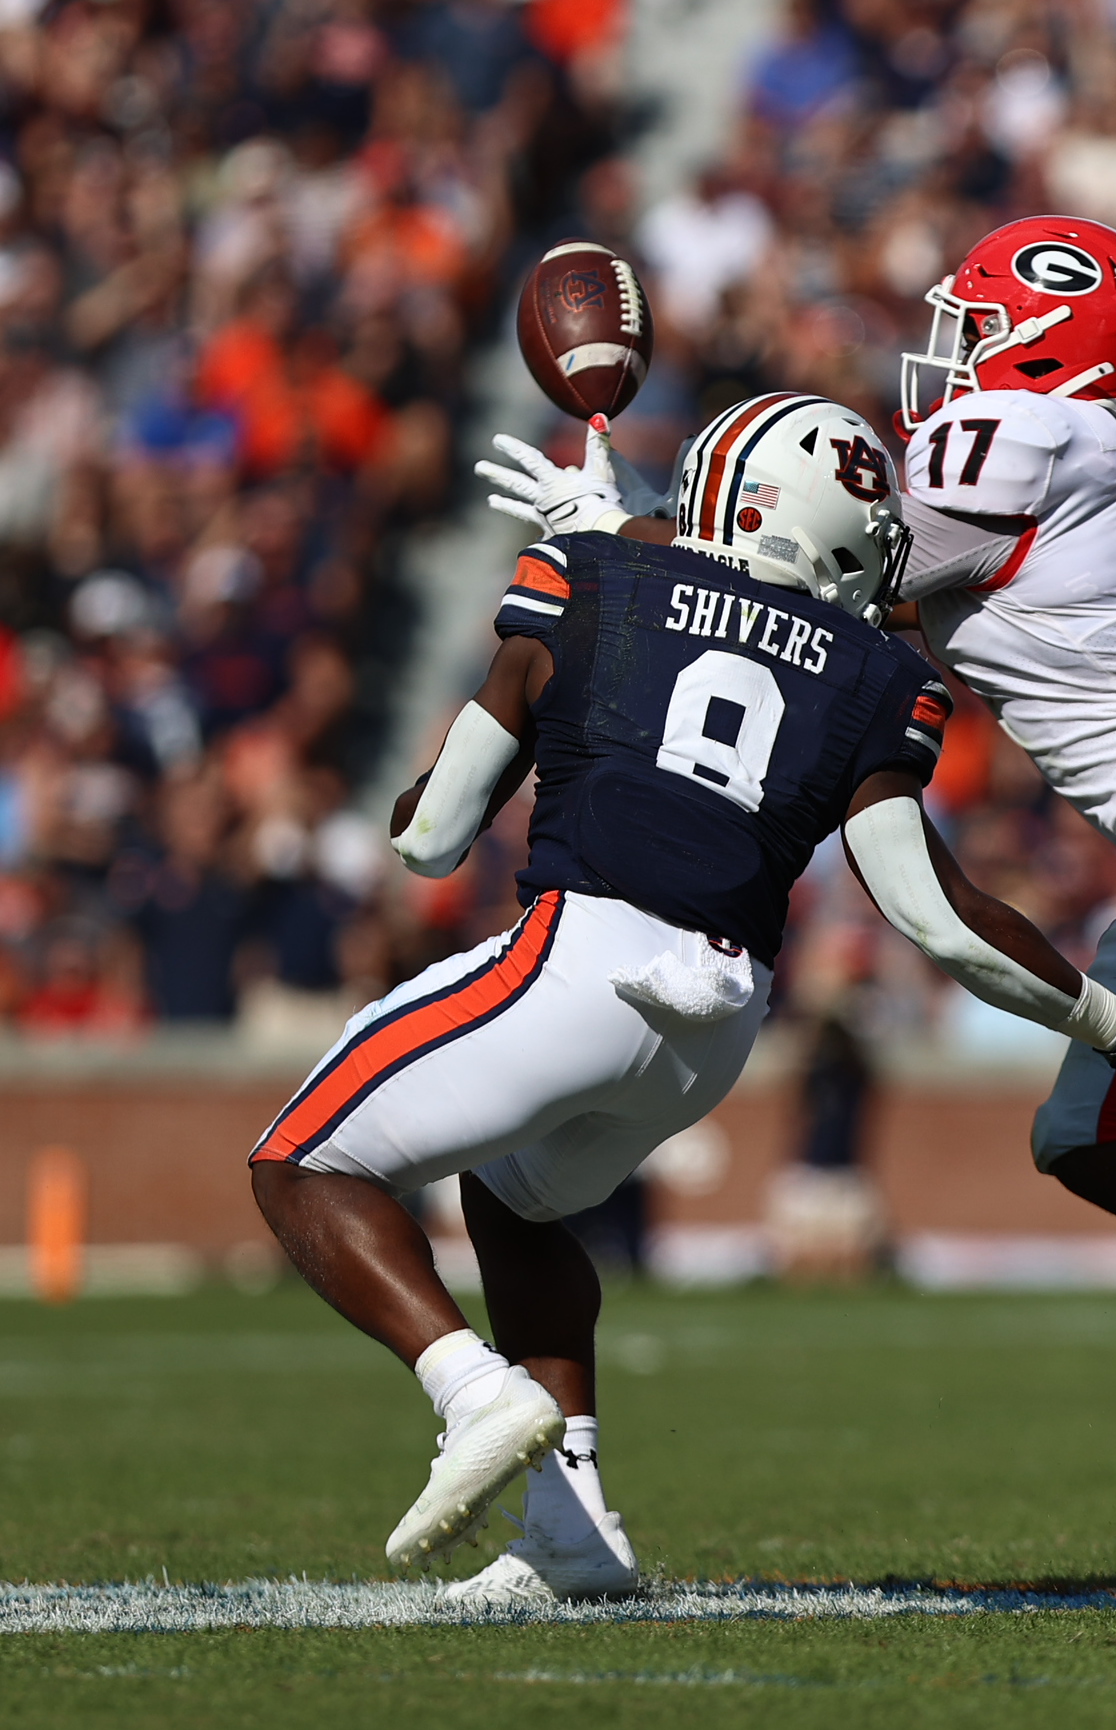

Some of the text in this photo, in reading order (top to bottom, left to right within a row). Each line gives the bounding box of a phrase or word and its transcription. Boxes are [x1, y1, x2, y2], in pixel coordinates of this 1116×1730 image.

[1015, 243, 1099, 293] G
[928, 418, 1002, 489] 17
[739, 509, 761, 530] SEC
[665, 584, 834, 674] SHIVERS
[655, 649, 786, 813] 8
